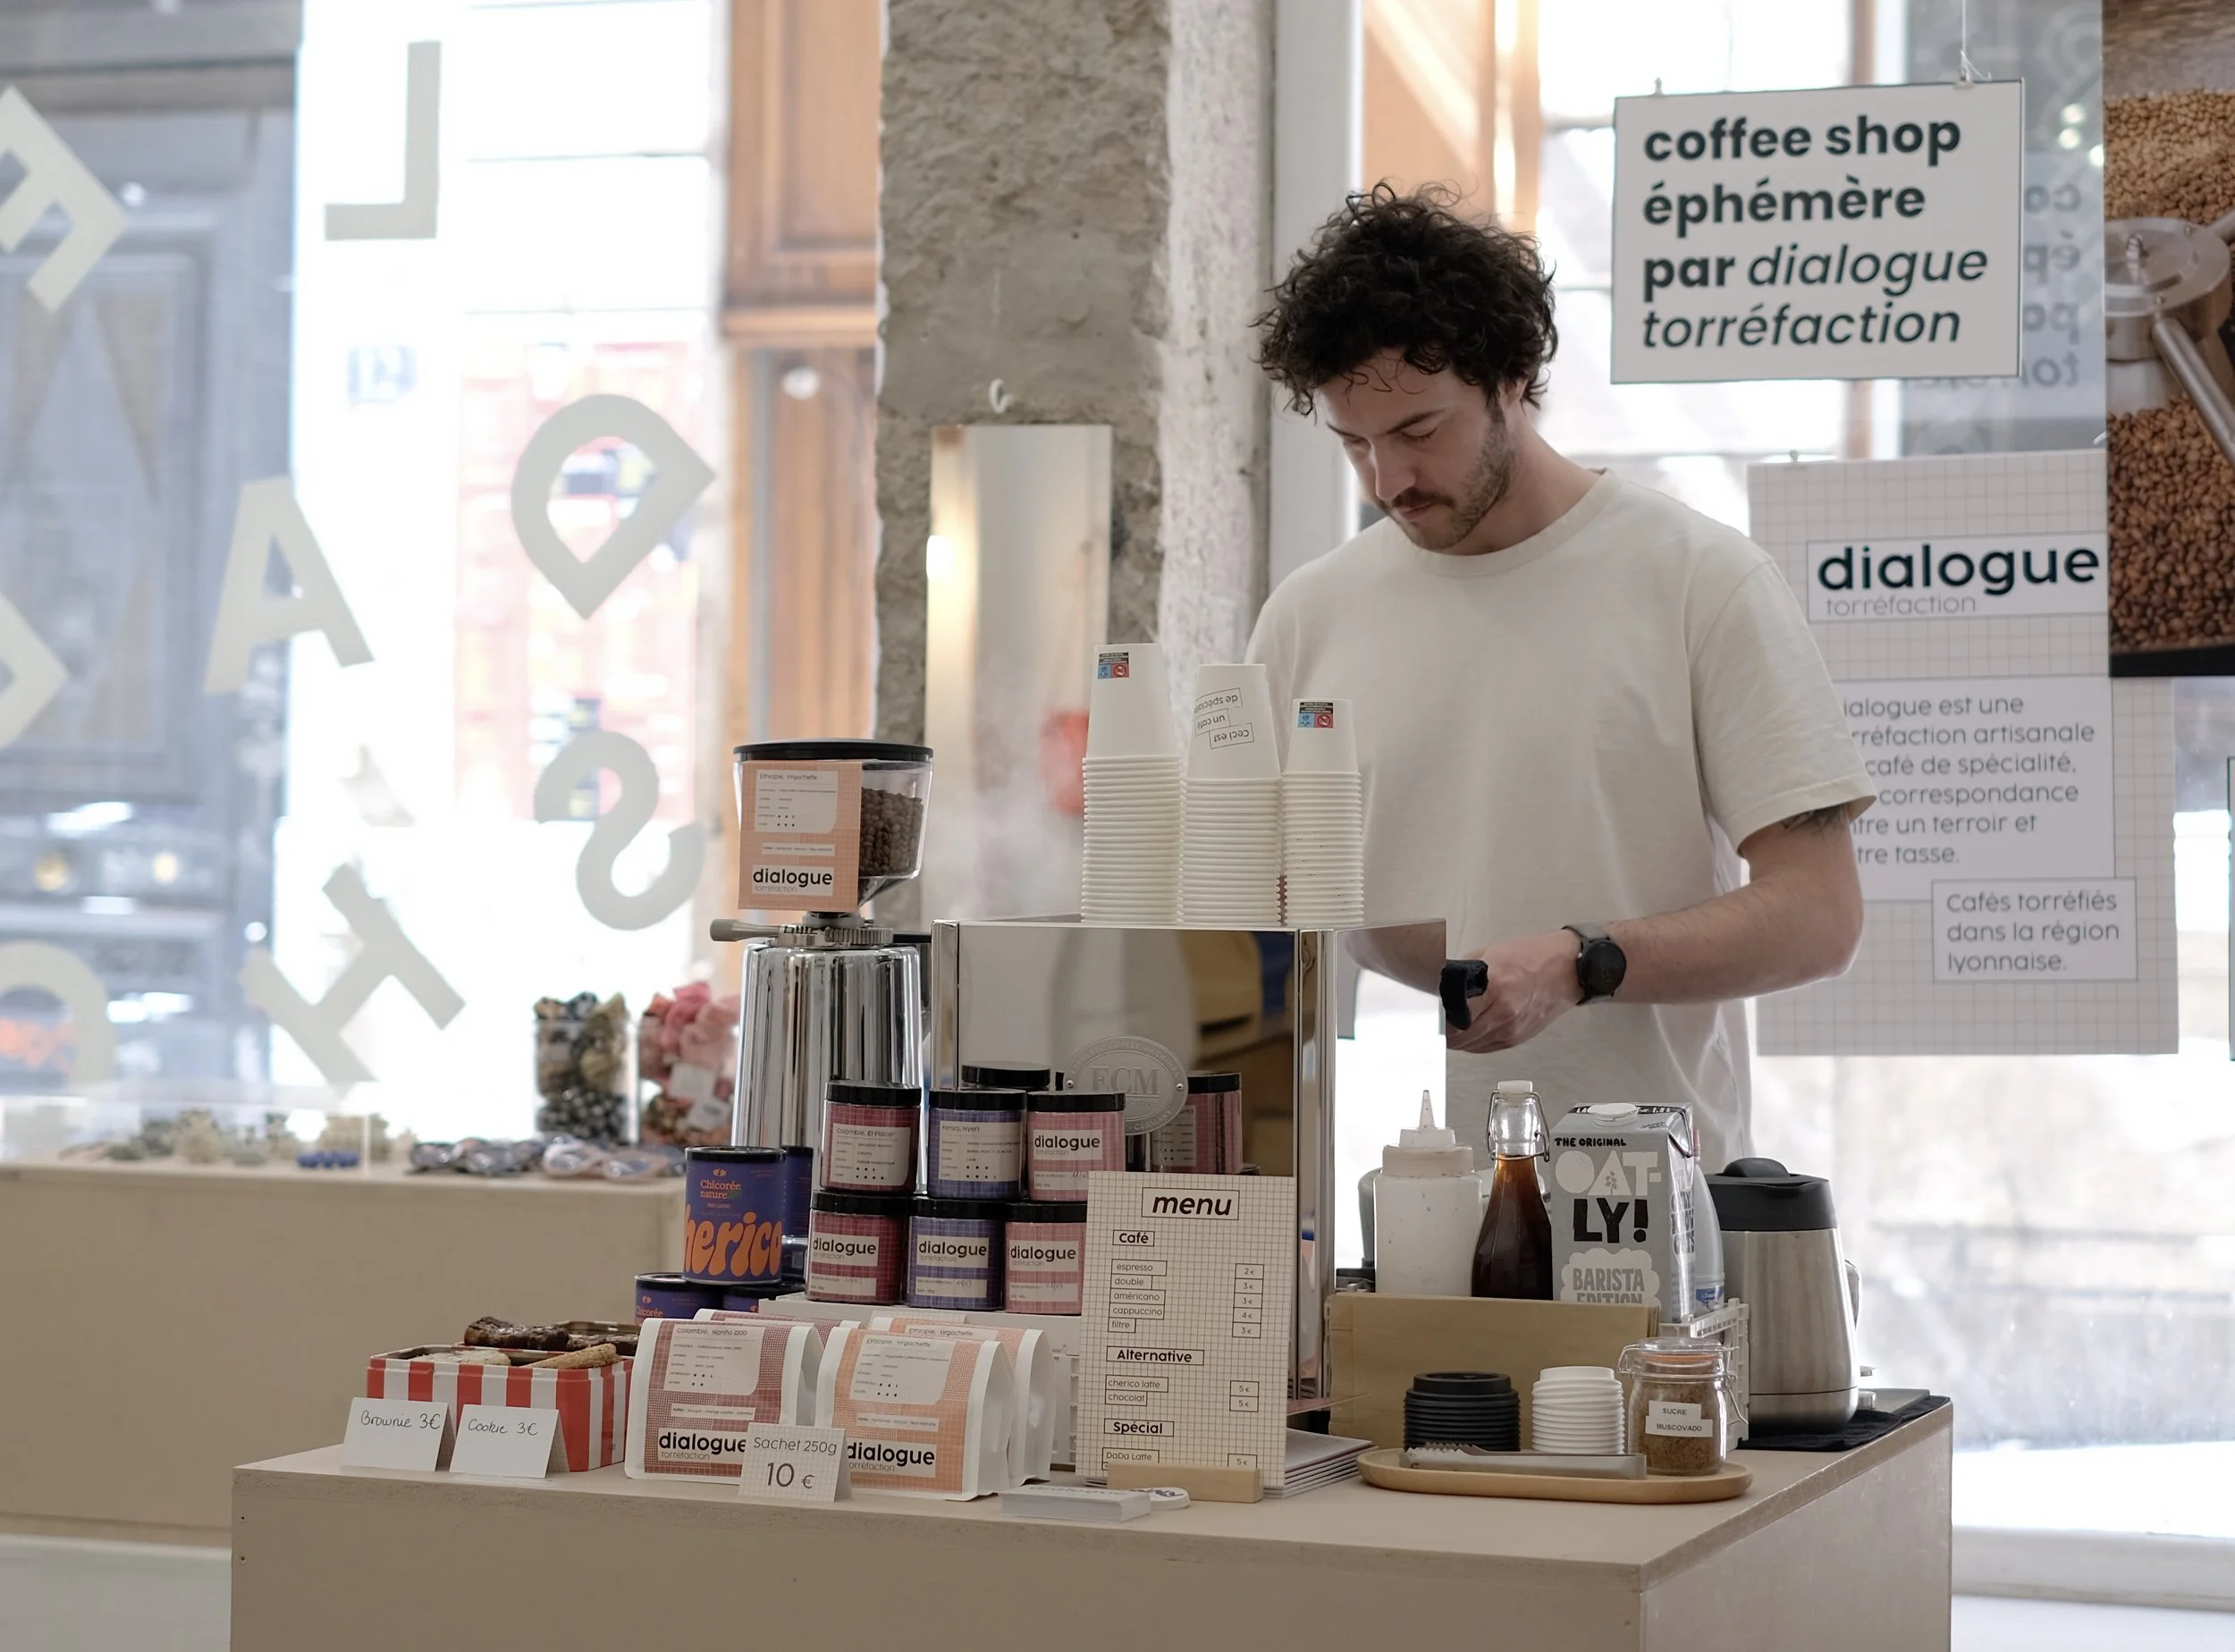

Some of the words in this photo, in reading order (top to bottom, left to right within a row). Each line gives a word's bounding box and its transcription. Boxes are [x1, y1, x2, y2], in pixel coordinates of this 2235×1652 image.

[1644, 116, 1812, 162] coffee
[1826, 114, 1961, 167] shop
[1643, 175, 1926, 238] éphémère
[1643, 257, 1735, 303] par
[1748, 243, 1988, 298] dialogue
[1643, 302, 1961, 349] torréfaction
[1818, 544, 2101, 595] dialogue
[1826, 594, 1977, 617] torréfaction
[1843, 697, 1932, 721] ialogue
[1939, 697, 1974, 716] est
[1979, 696, 2024, 714] une
[1851, 724, 1967, 746] rréfaction
[1974, 722, 2094, 743] artisanale
[1865, 754, 1914, 776] café
[1921, 754, 1951, 775] de
[1958, 752, 2077, 780] spécialité,
[1879, 783, 2079, 806] correspondance
[1851, 815, 1890, 836] tre
[1896, 817, 1926, 835] un
[1932, 813, 2008, 835] terroir
[2015, 813, 2037, 833] et
[1857, 846, 1889, 864] tre
[1895, 844, 1961, 864] tasse.
[753, 868, 832, 889] dialogue
[1947, 890, 2011, 914] Cafés
[2018, 889, 2117, 913] torréfiés
[1947, 921, 2006, 943] dans
[2013, 920, 2035, 942] la
[2041, 917, 2120, 945] région
[1947, 949, 2066, 975] lyonnaise.
[1089, 1066, 1161, 1095] ECM
[1034, 1134, 1101, 1151] dialogue
[1554, 1137, 1576, 1147] THE
[1578, 1137, 1627, 1147] ORIGINAL
[701, 1179, 742, 1192] Chicorée
[1152, 1195, 1232, 1216] menu
[1573, 1197, 1649, 1243] LY!
[813, 1237, 877, 1256] dialogue
[1119, 1231, 1149, 1244] Café
[919, 1240, 988, 1259] dialogue
[1010, 1245, 1076, 1262] dialogue
[1116, 1263, 1153, 1273] espresso
[1114, 1277, 1144, 1286] double
[1573, 1268, 1645, 1292] BARISTA
[1113, 1291, 1160, 1301] américano
[1112, 1305, 1163, 1317] cappuccino
[1111, 1319, 1130, 1329] filtre
[1117, 1349, 1193, 1362] Alternative
[1108, 1378, 1141, 1387] cherico
[1142, 1379, 1160, 1388] latte
[1108, 1393, 1146, 1402] chocolat
[359, 1409, 412, 1429] Brownie
[418, 1412, 442, 1431] 3€
[1662, 1407, 1687, 1416] SUCRE
[468, 1418, 508, 1435] Cookie
[518, 1421, 538, 1437] 3€
[1113, 1420, 1163, 1436] Spécial
[1656, 1422, 1703, 1432] MUSCOVADO
[659, 1431, 746, 1456] dialogue
[753, 1437, 801, 1451] Sachet
[803, 1440, 837, 1456] 250g
[661, 1451, 710, 1460] torréfaction
[848, 1442, 935, 1466] dialogue
[1106, 1451, 1130, 1460] DaDa
[1131, 1452, 1152, 1461] Latte
[767, 1462, 795, 1488] 10
[801, 1474, 815, 1489] €
[849, 1462, 896, 1472] orréfaction
